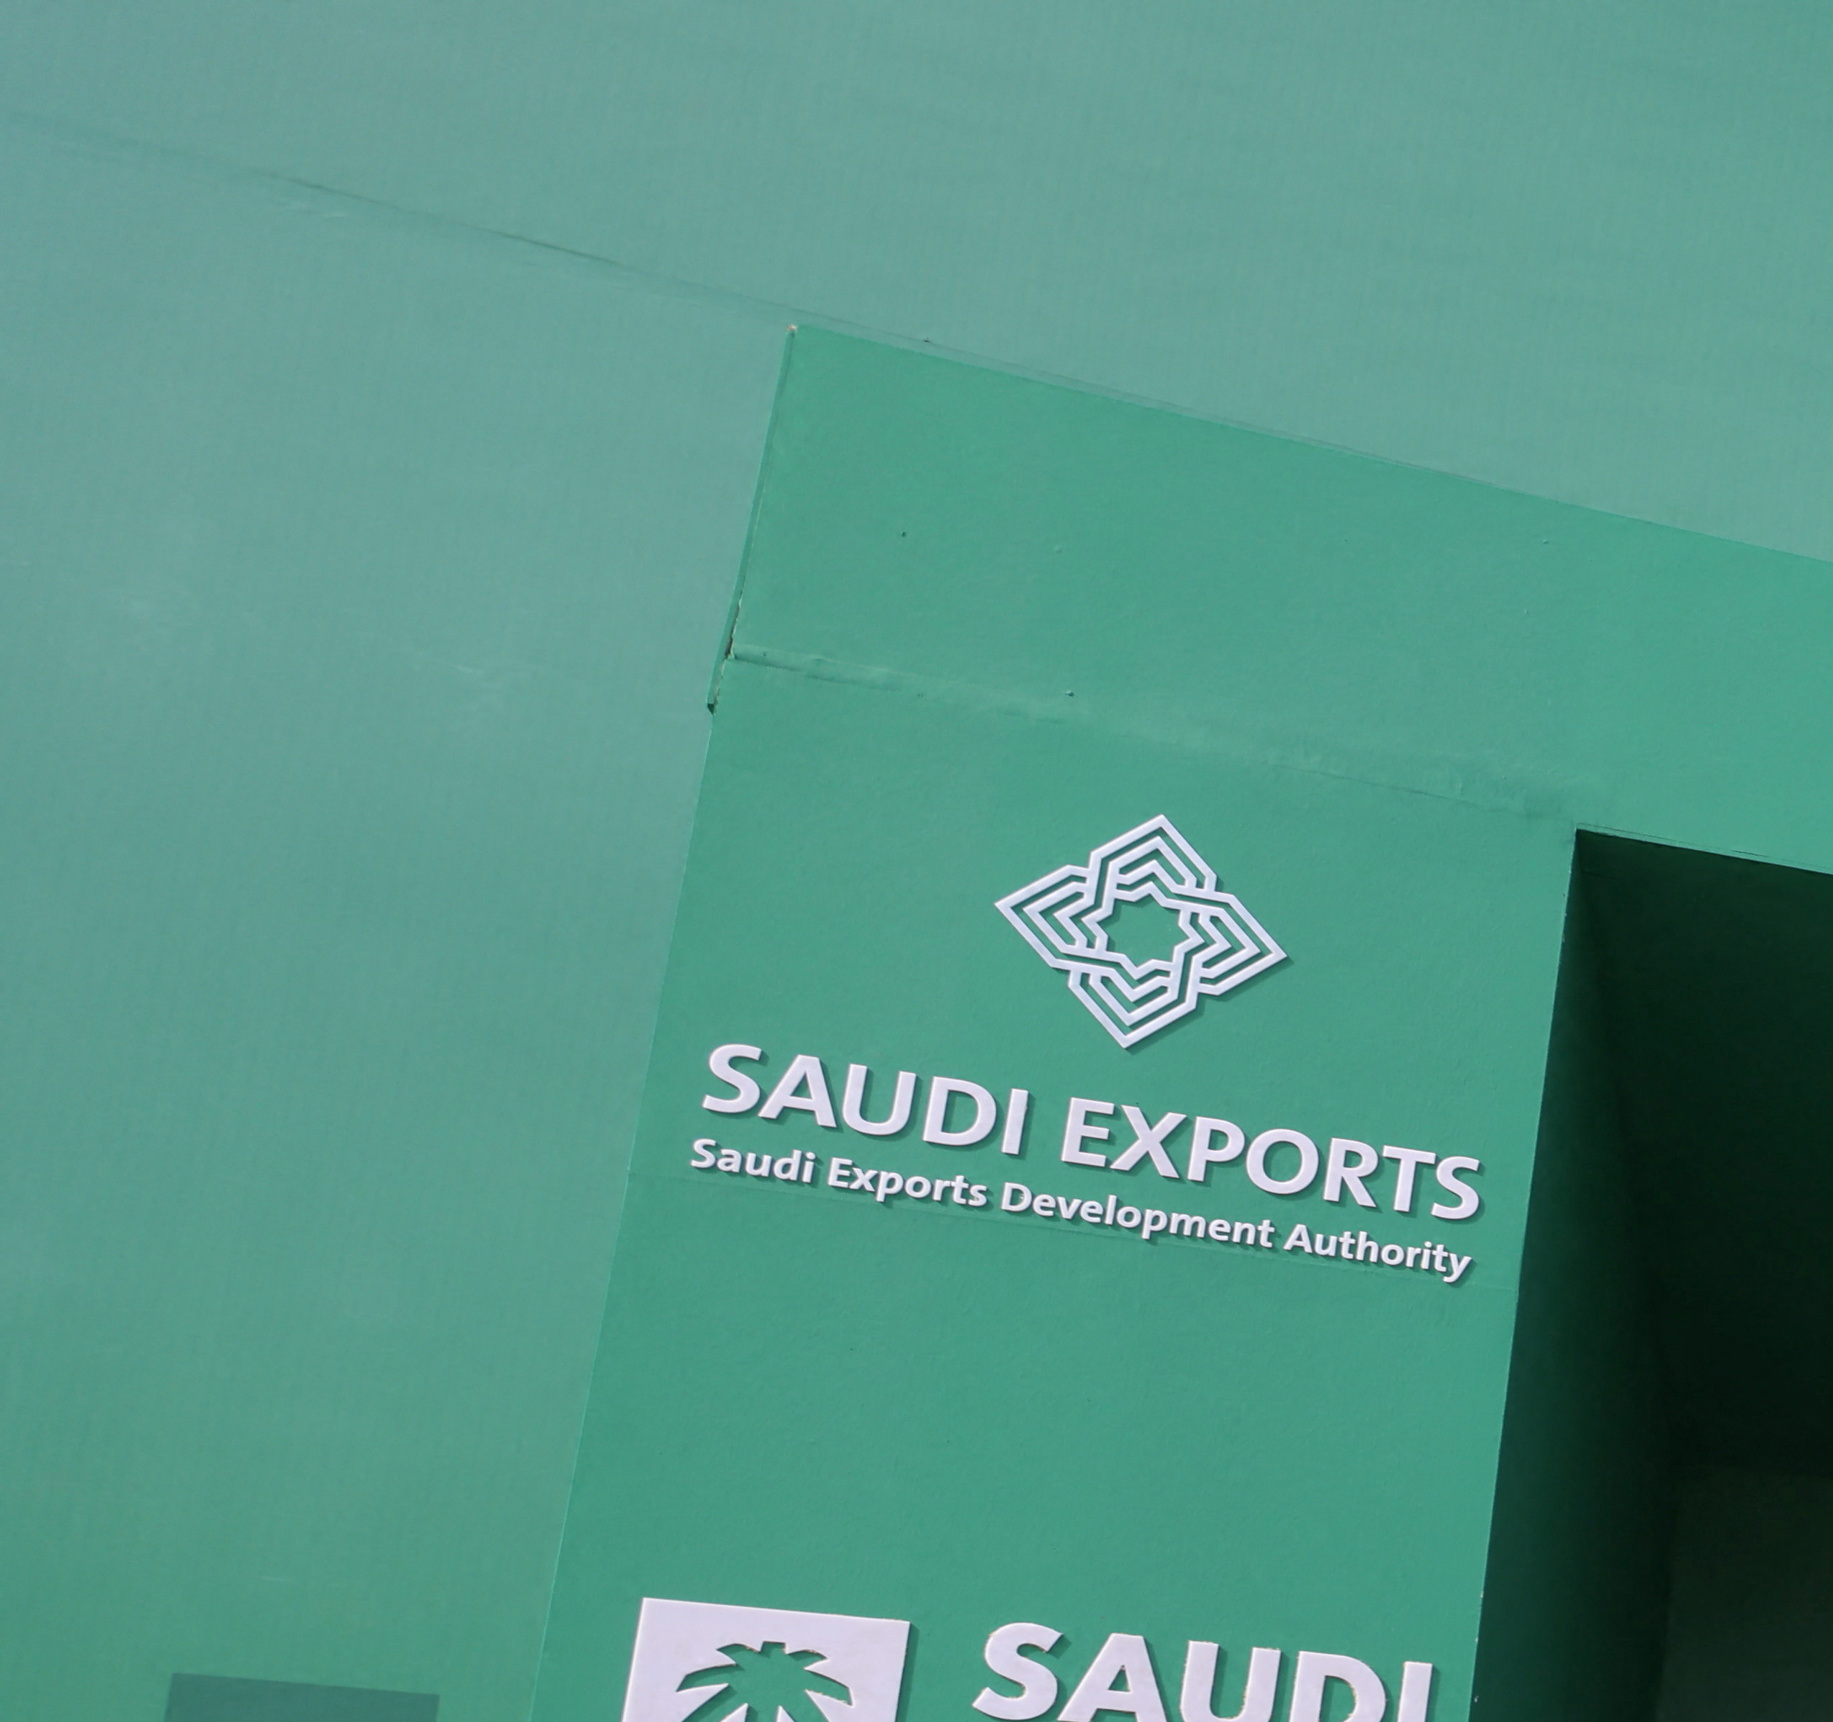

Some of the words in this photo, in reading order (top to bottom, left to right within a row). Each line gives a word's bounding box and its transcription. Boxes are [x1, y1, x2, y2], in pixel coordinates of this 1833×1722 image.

[690, 1138, 816, 1184] Saudi
[827, 1156, 989, 1209] Exports
[1000, 1182, 1275, 1250] Development
[1285, 1222, 1473, 1284] Authority
[701, 1043, 1031, 1155] SAUDI
[1061, 1096, 1483, 1220] EXPORTS
